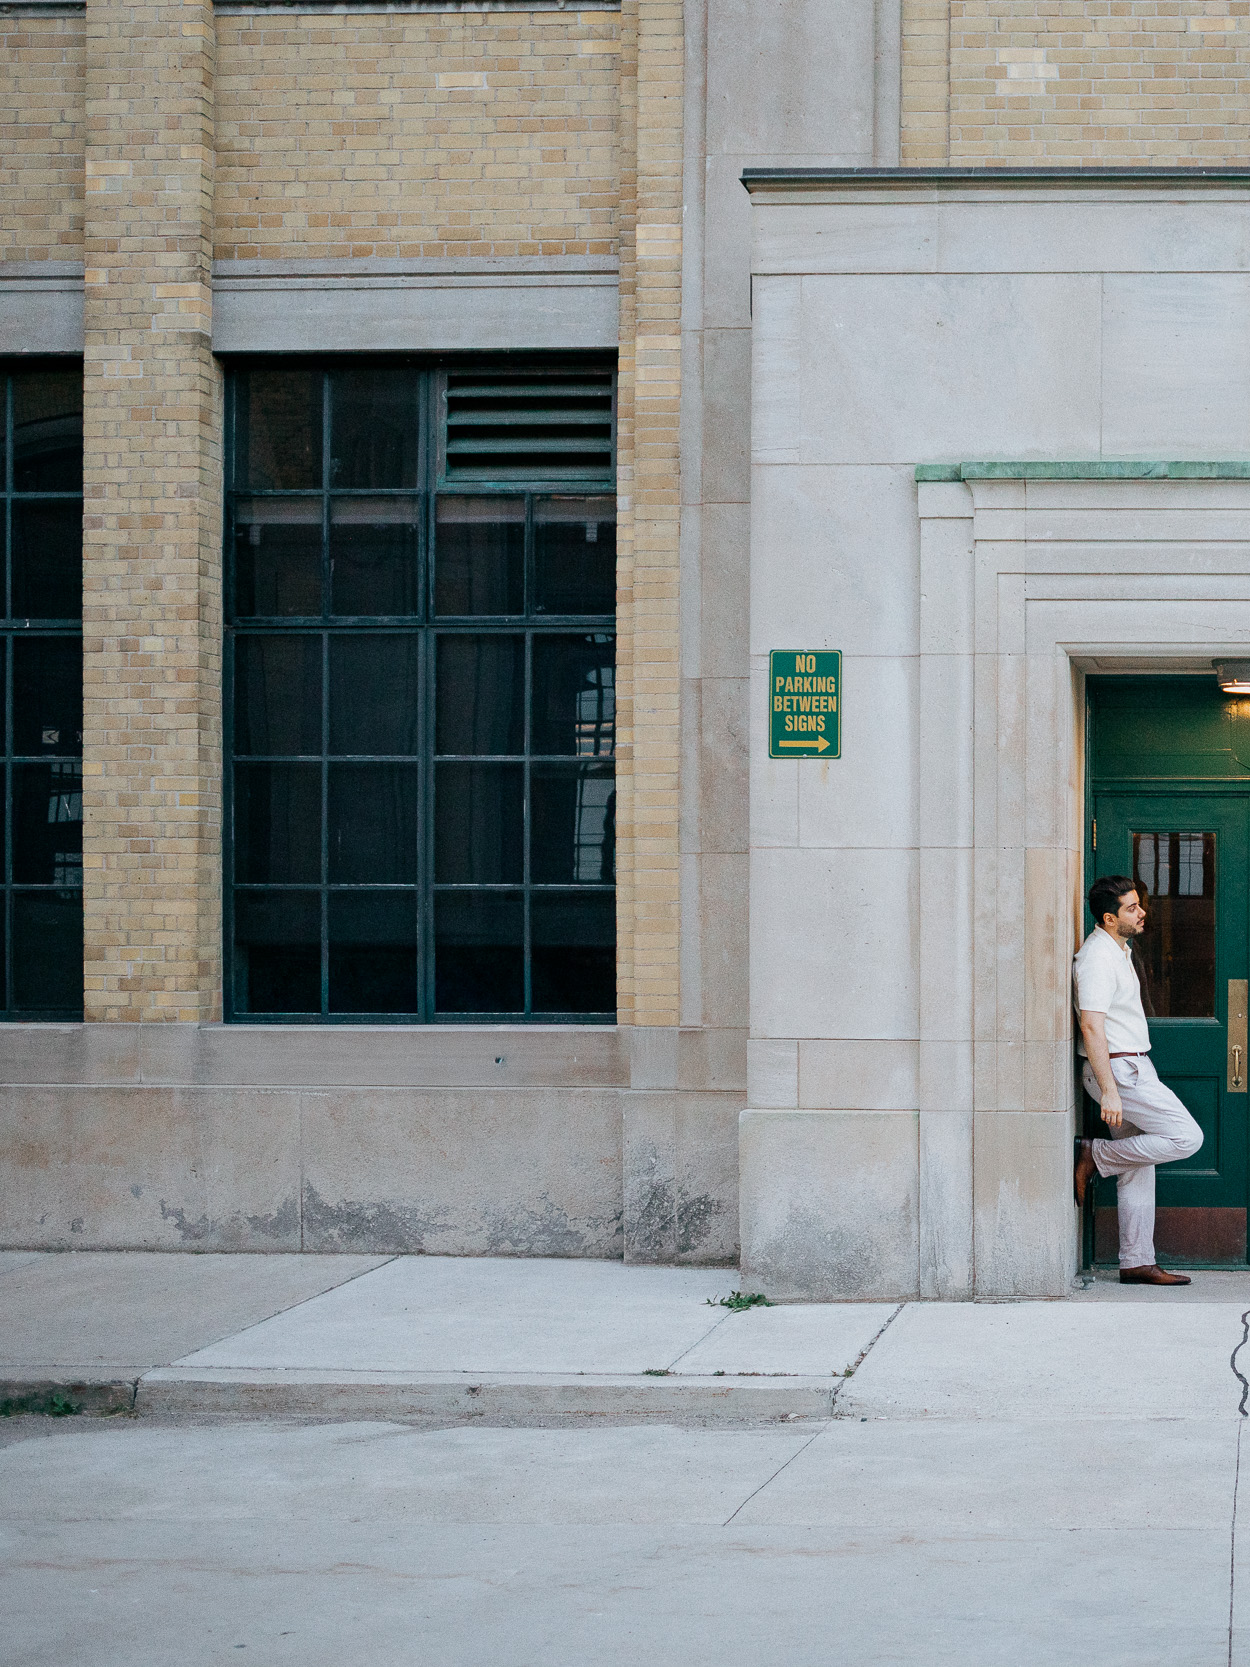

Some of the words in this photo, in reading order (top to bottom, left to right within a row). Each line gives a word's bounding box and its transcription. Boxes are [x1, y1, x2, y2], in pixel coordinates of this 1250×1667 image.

[795, 654, 816, 673] NO
[775, 676, 836, 693] PARKING
[773, 695, 837, 712] BETWEEN
[784, 714, 826, 732] SIGNS
